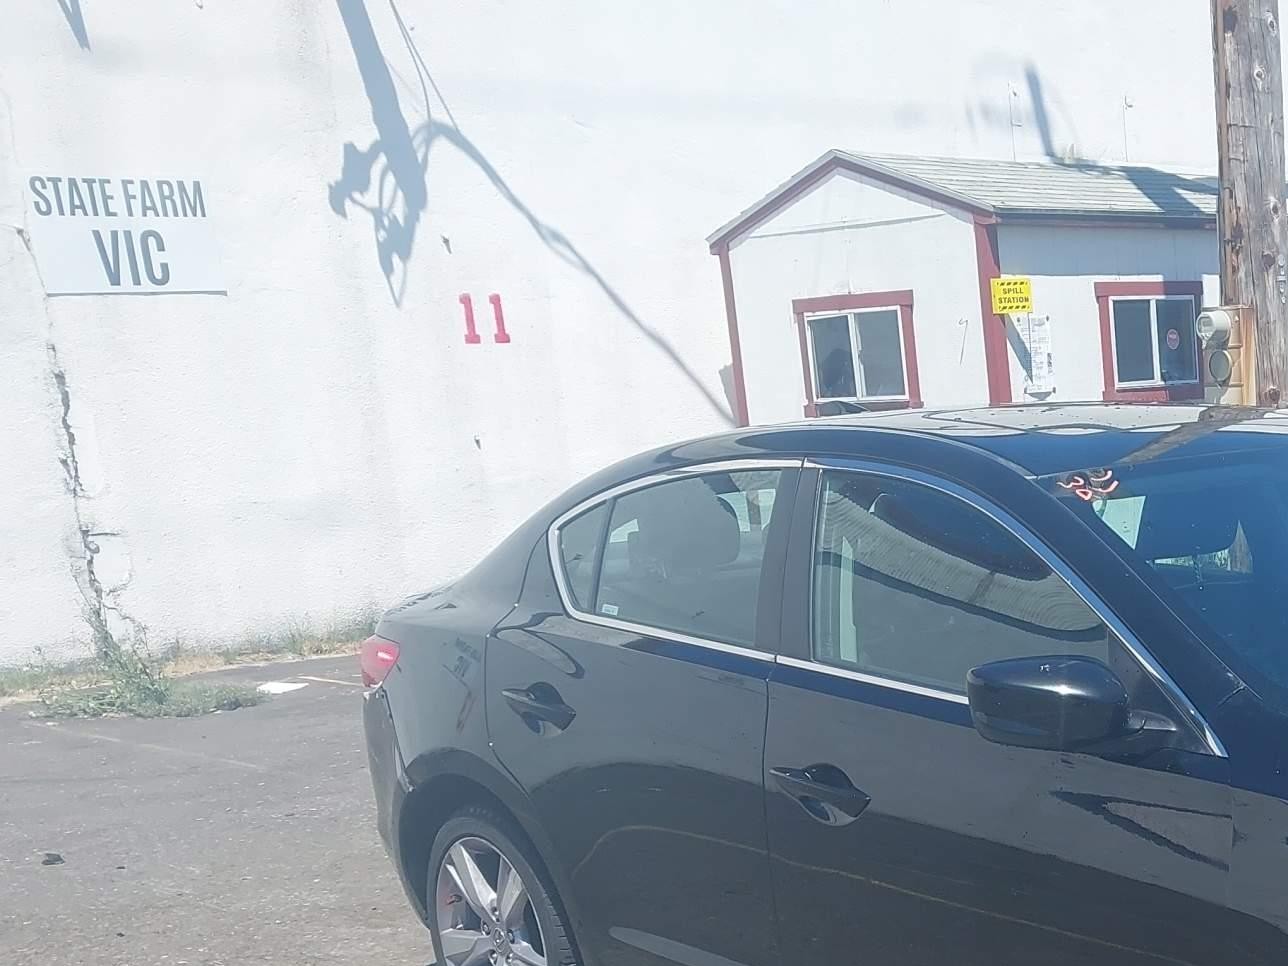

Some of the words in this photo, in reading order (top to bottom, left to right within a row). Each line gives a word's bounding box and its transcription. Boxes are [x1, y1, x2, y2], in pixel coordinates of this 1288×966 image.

[29, 176, 118, 217] STATE
[121, 179, 207, 218] FARM
[92, 229, 170, 287] VIC
[998, 296, 1030, 305] STATION
[1002, 287, 1024, 295] SPILL
[459, 293, 511, 344] 11
